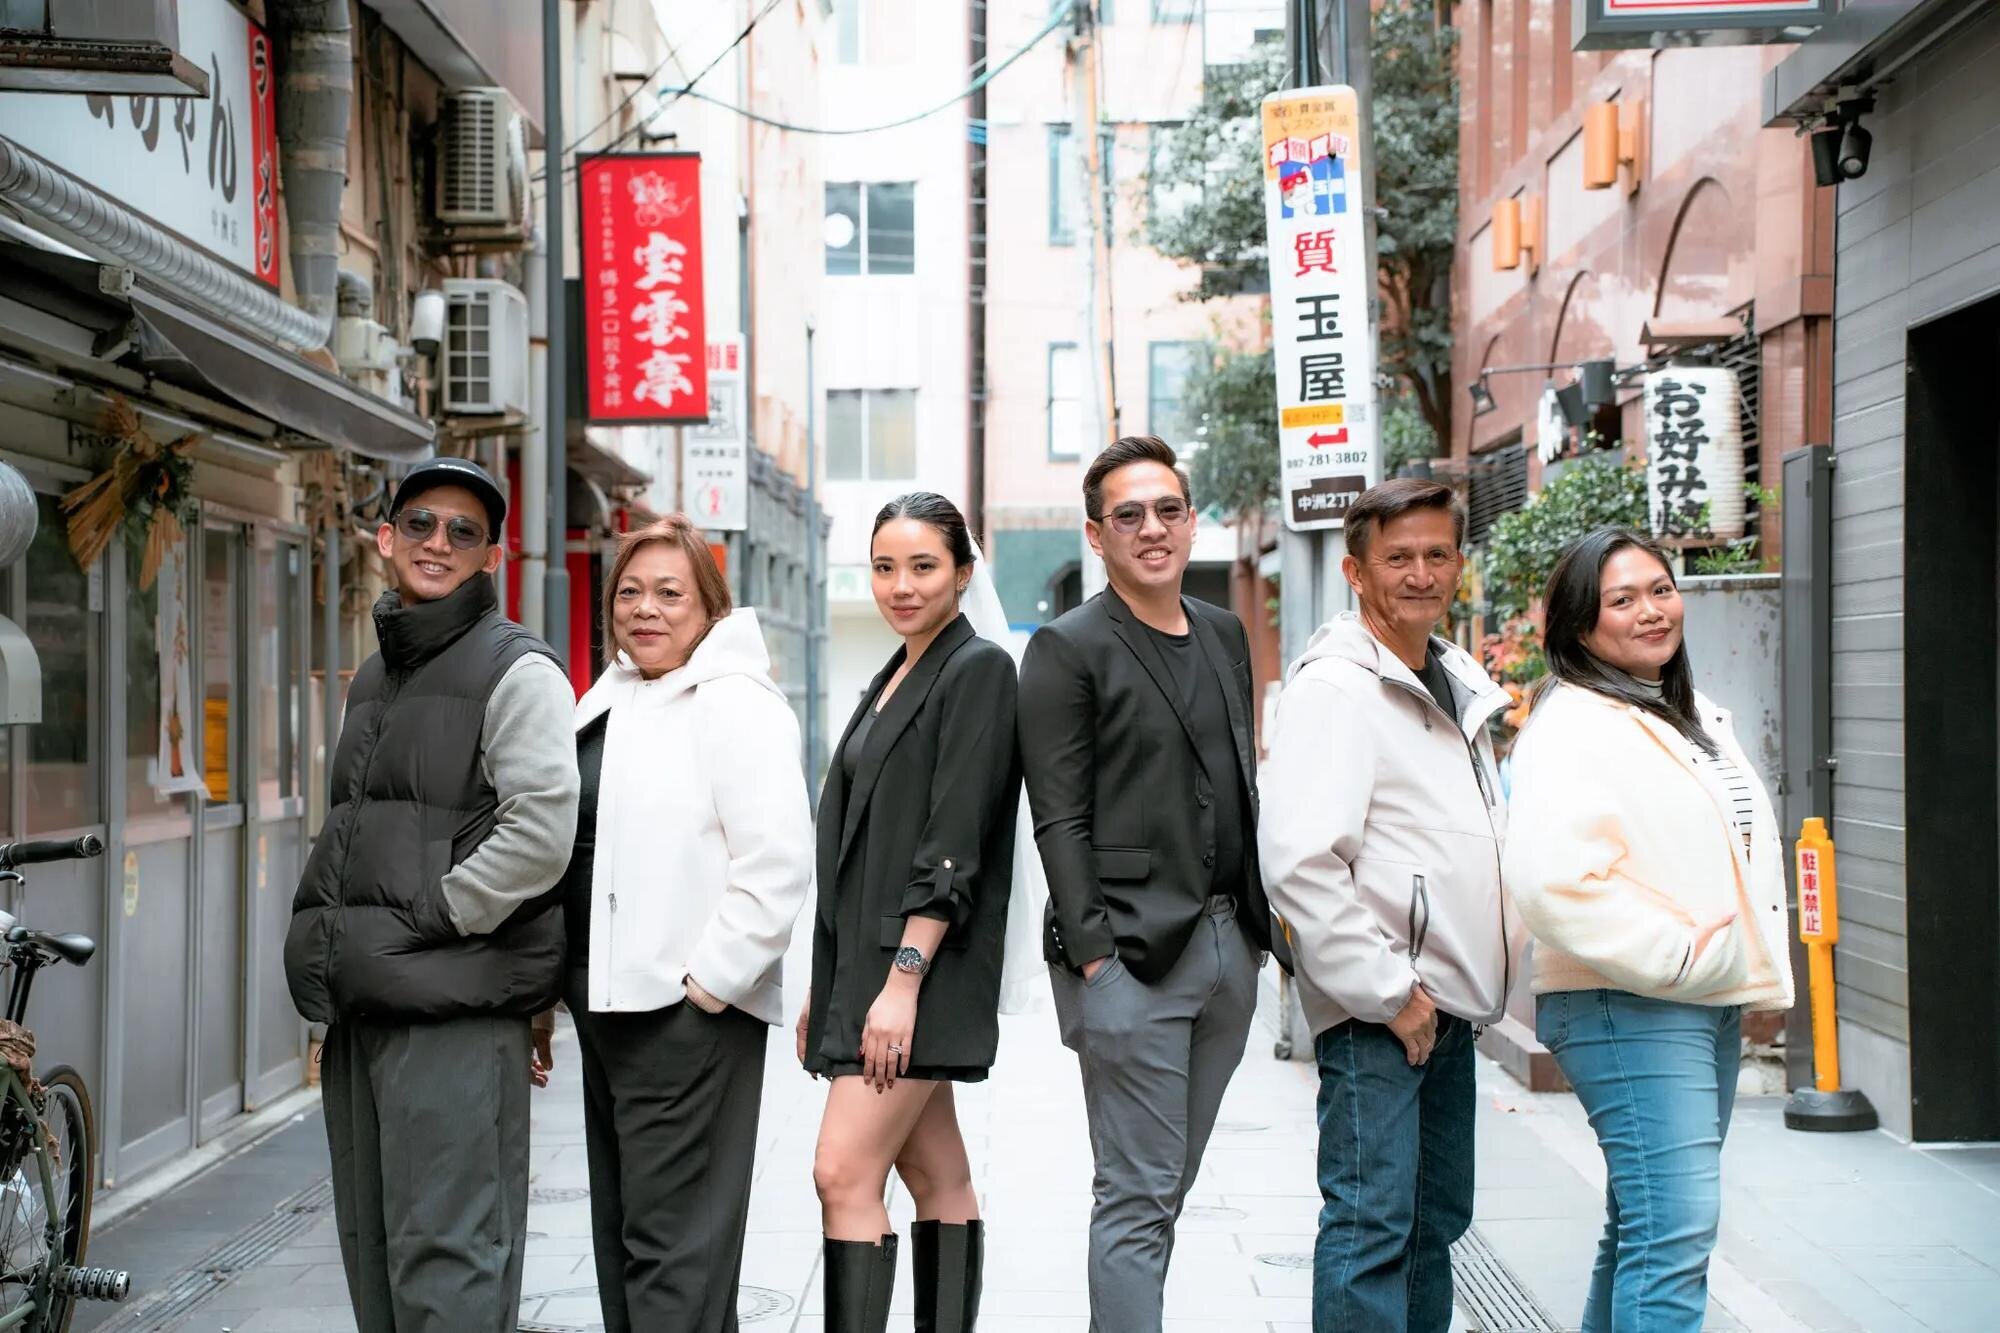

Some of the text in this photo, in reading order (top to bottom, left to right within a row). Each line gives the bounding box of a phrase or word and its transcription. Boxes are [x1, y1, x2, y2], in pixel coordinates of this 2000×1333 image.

[254, 34, 273, 275] ラーメン
[631, 231, 694, 409] 宝雲亭
[1801, 852, 1820, 932] 駐車禁止
